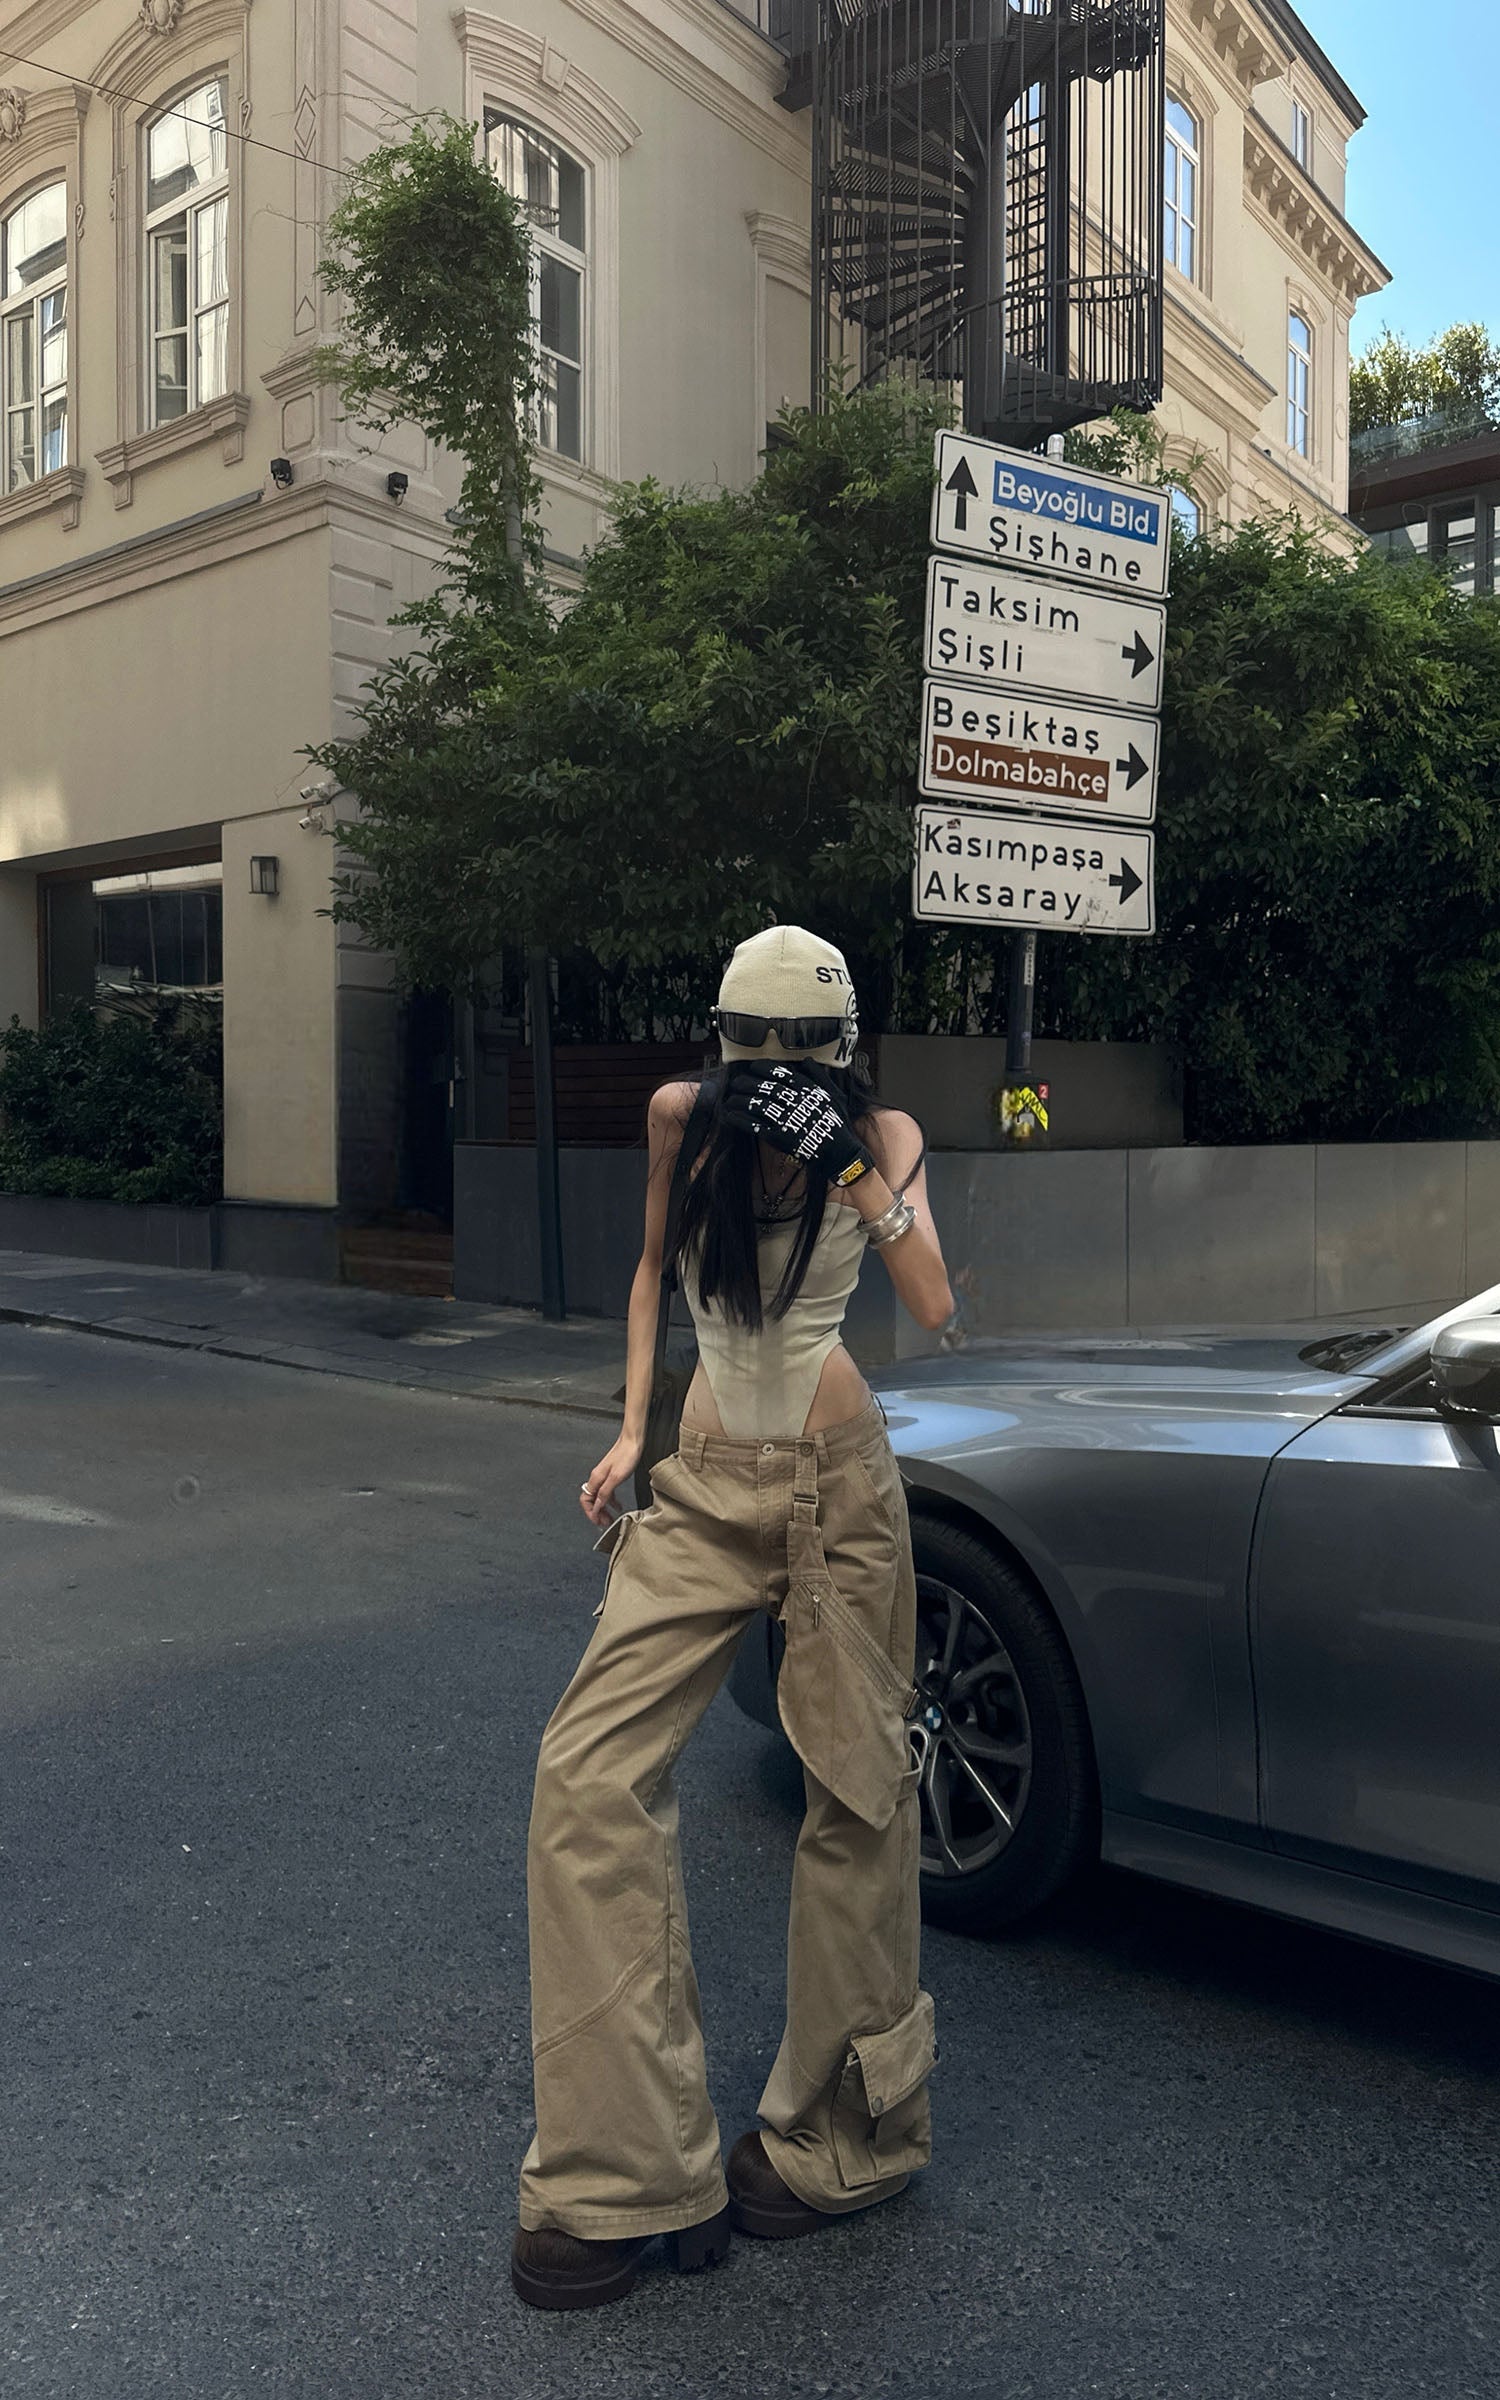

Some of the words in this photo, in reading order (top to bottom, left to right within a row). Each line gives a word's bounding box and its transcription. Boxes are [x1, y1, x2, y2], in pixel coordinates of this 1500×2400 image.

[998, 470, 1102, 523] Beyoğlu
[1110, 501, 1156, 537] Bld.
[989, 516, 1141, 581] Şişhane
[940, 576, 1079, 632] Taksim
[938, 628, 1023, 672] Şişli
[933, 696, 1099, 754] Beşiktaş
[935, 744, 1106, 796] Dolmabahçe
[925, 824, 1103, 871] Kasımpaşa
[924, 871, 1081, 920] Aksaray
